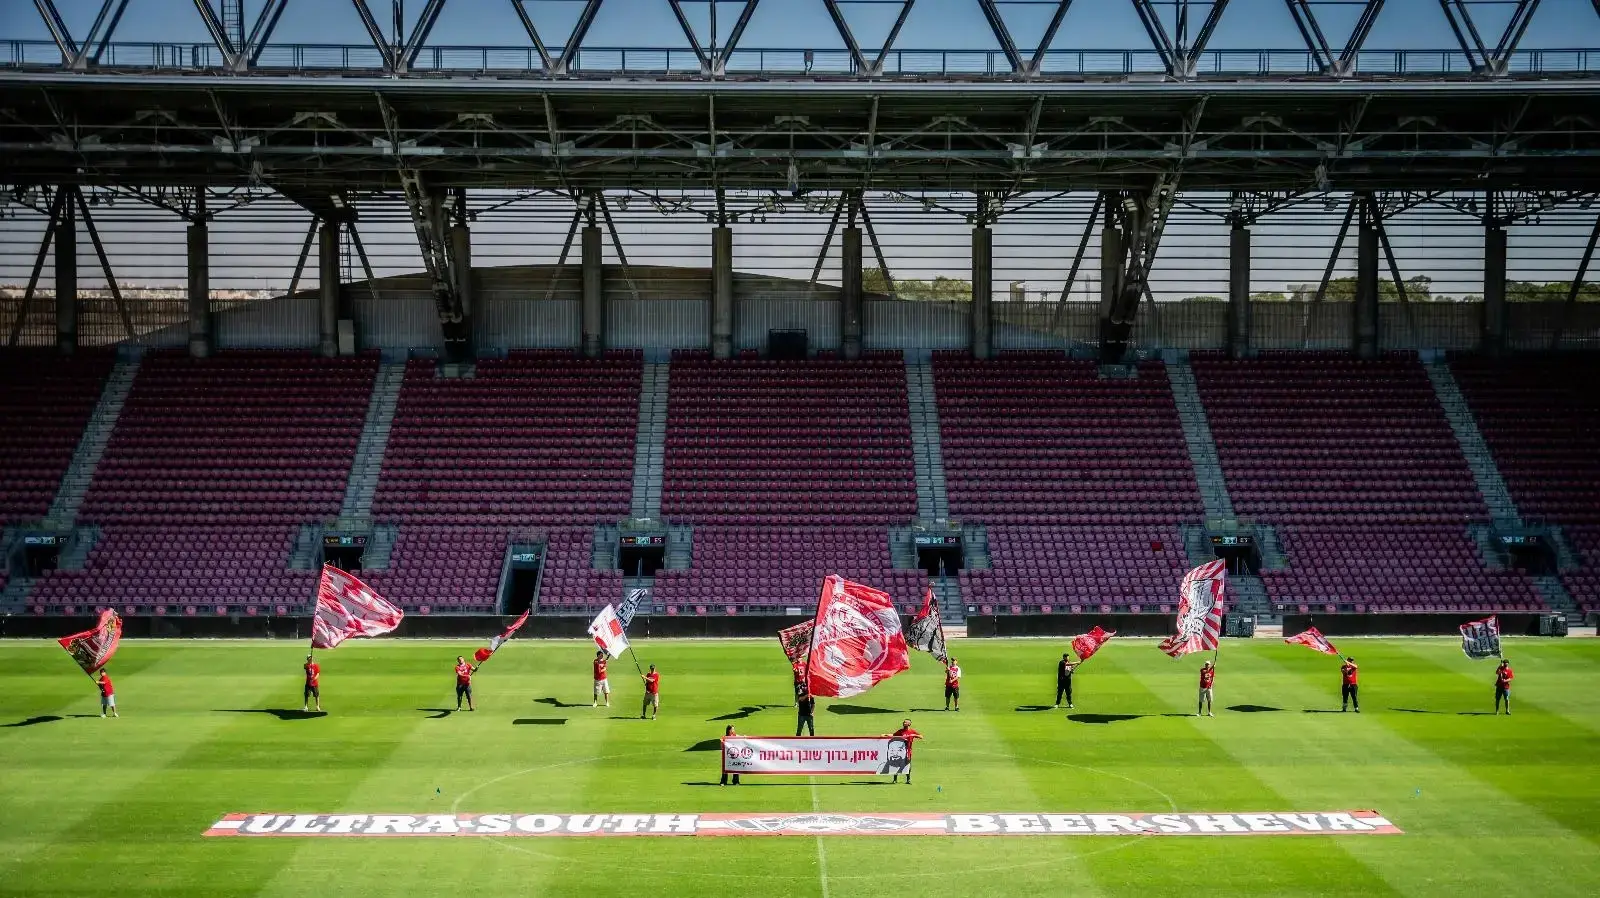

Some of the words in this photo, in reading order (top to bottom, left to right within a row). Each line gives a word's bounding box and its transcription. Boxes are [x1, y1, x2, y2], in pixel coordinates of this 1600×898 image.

[759, 750, 793, 761] הביתה
[796, 750, 822, 763] שובך
[825, 750, 848, 763] ברוך
[850, 750, 879, 763] איתן,
[244, 814, 460, 834] ULTRA
[475, 814, 700, 833] SOUTH
[950, 814, 1157, 834] BEER
[1150, 813, 1377, 833] SHEVA
